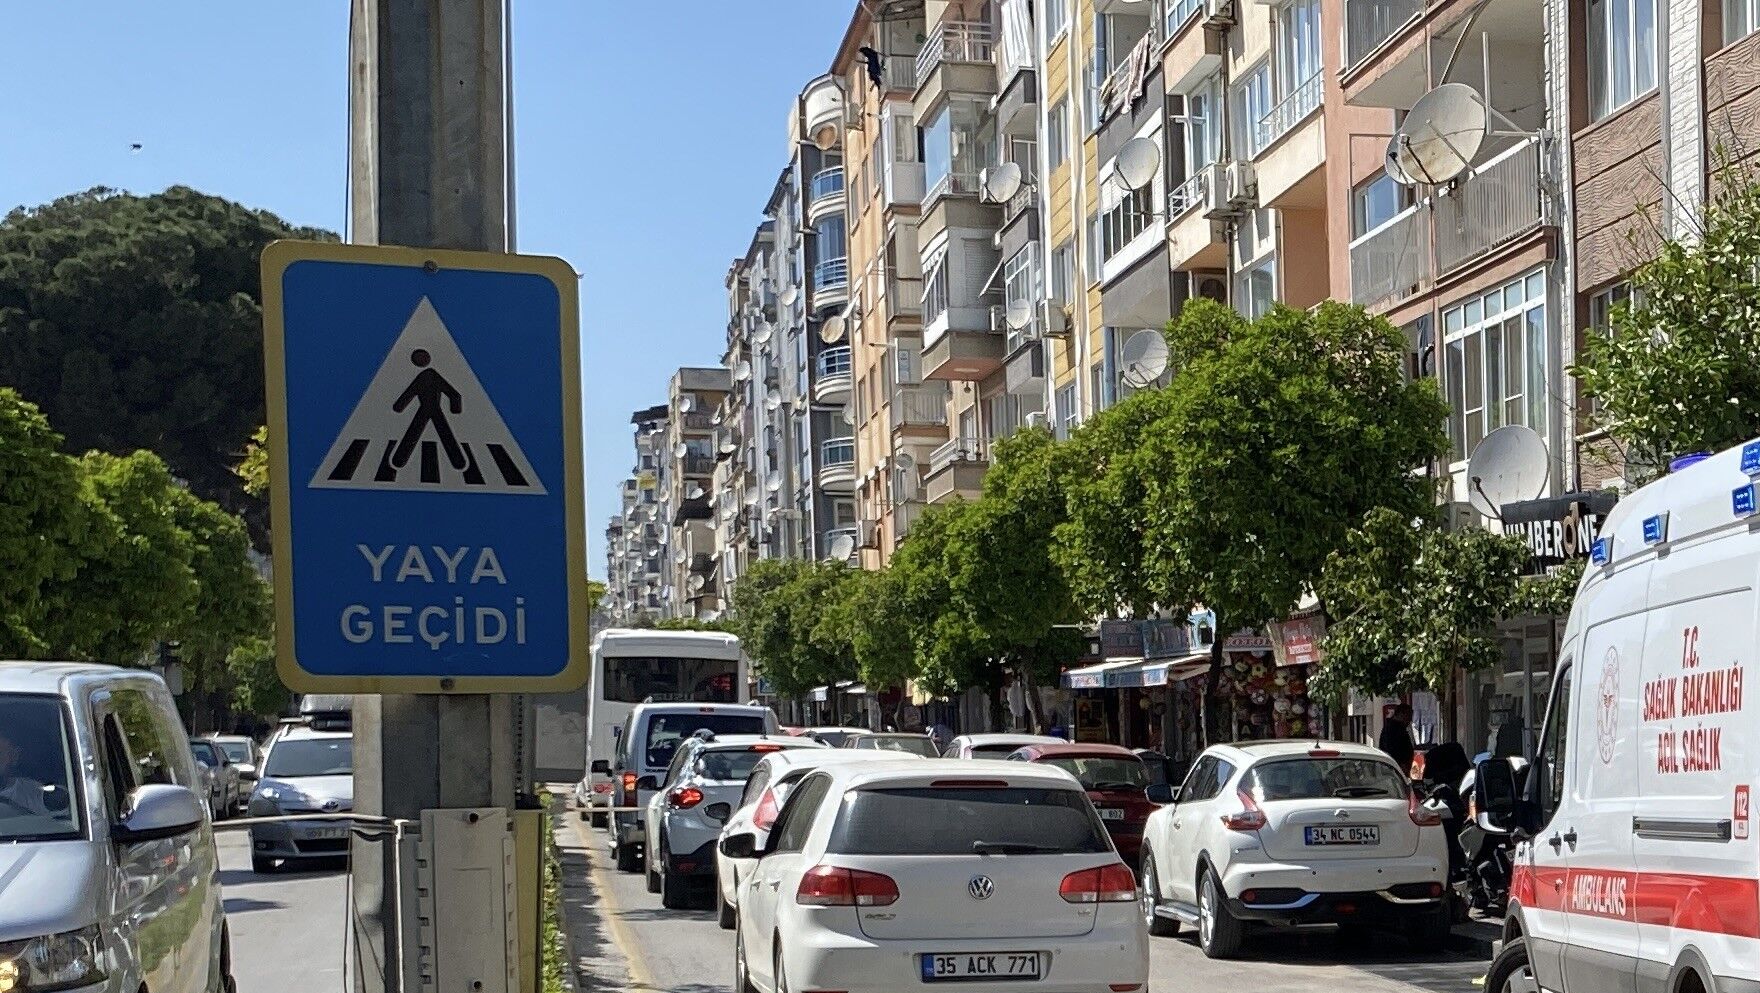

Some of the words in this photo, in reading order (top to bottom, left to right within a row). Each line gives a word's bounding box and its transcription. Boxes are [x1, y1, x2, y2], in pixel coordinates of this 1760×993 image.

[356, 544, 507, 584] YAYA
[341, 596, 526, 650] GEÇİDİ
[1681, 626, 1699, 668] T.C.
[1643, 673, 1677, 722] SAĞLIK
[1682, 660, 1744, 717] BAKANLIĞI
[1657, 724, 1679, 774] ACİL
[1682, 722, 1721, 772] SAĞLIK
[1737, 791, 1747, 817] 112
[1313, 828, 1327, 841] 34
[1330, 828, 1345, 841] NC
[1349, 828, 1376, 841] 0544
[1571, 874, 1627, 917] AMBULANS
[936, 957, 957, 974] 35
[967, 956, 996, 974] ACK
[1008, 956, 1036, 974] 771
